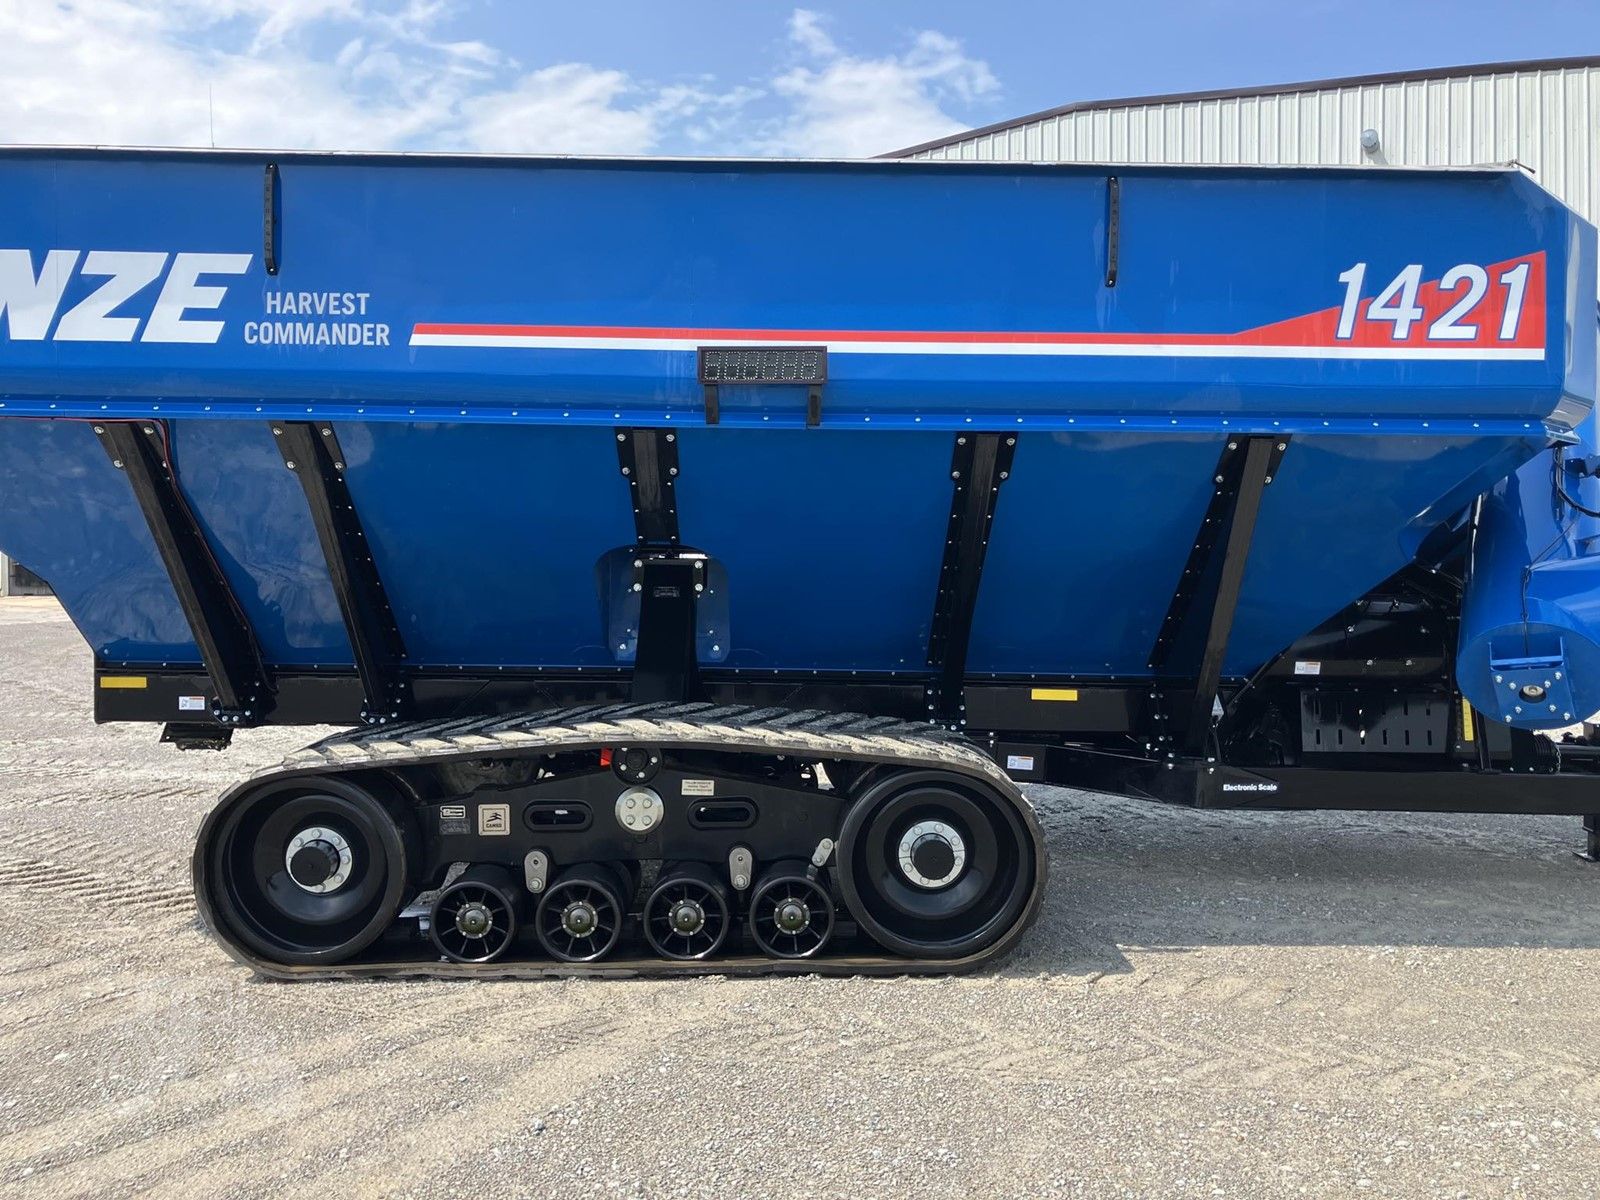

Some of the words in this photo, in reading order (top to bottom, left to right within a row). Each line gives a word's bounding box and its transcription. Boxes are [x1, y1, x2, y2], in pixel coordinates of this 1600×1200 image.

[266, 291, 370, 316] HARVEST
[1336, 262, 1530, 341] 1421
[244, 320, 391, 346] COMMANDER
[1222, 783, 1257, 792] Electronic
[1258, 783, 1278, 792] Scale
